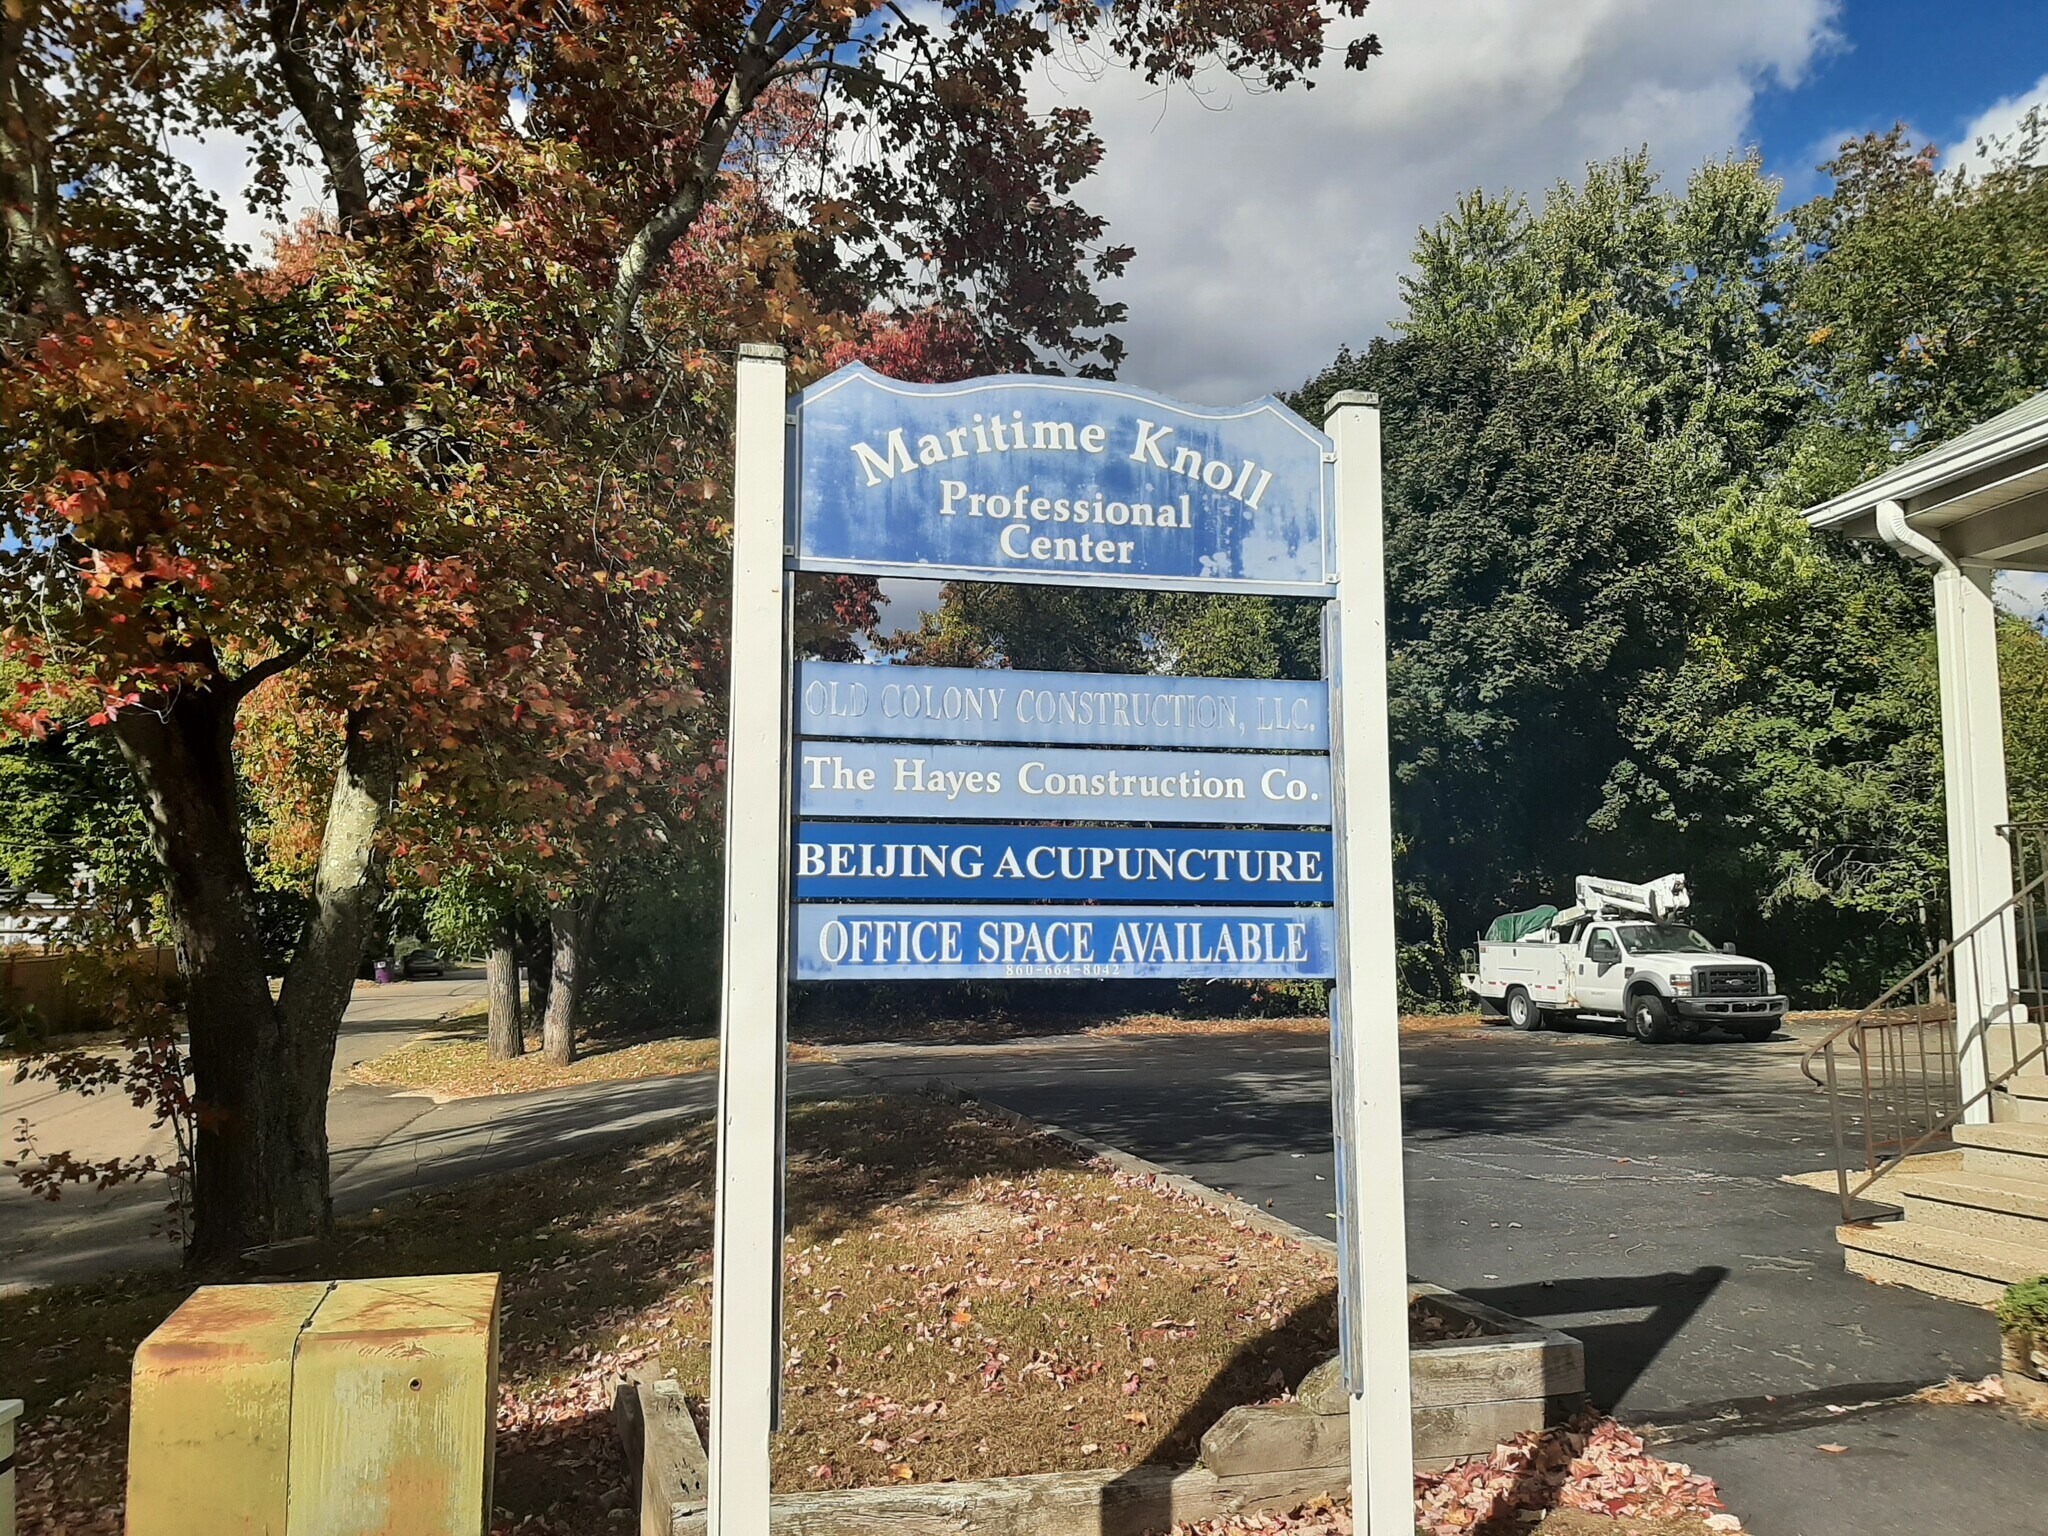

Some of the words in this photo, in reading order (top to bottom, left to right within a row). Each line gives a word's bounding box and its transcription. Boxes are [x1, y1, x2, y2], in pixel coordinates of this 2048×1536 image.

[851, 409, 1106, 487] Maritime
[1130, 418, 1273, 510] Knoll
[939, 479, 1193, 529] Professional
[1000, 523, 1135, 565] Center
[804, 679, 870, 718] OLD
[880, 682, 1006, 722] COLONY
[1016, 688, 1246, 735] CONSTRUCTION,
[1256, 697, 1316, 732] LLC.
[803, 755, 876, 791] The
[892, 758, 1001, 801] Hayes
[1018, 761, 1246, 800] Construction
[1260, 768, 1319, 801] Co.
[796, 843, 983, 879] BEIJING
[992, 845, 1323, 883] ACUPUNCTURE
[819, 920, 963, 963] OFFICE
[977, 921, 1096, 963] SPACE
[1107, 922, 1310, 964] AVAILABLE
